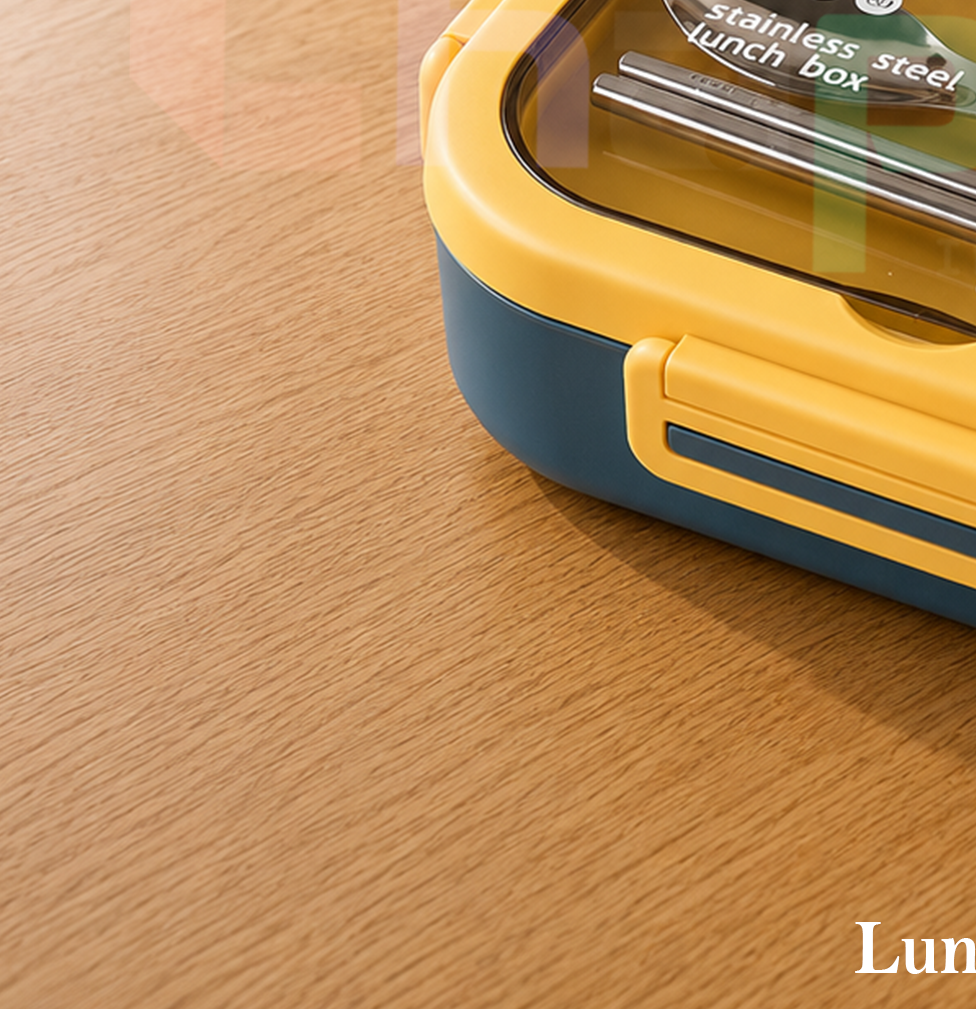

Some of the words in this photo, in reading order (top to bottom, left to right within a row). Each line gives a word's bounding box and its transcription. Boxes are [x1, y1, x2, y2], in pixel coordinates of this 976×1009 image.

[687, 21, 786, 69] lunch
[798, 53, 869, 93] box
[704, 3, 860, 60] stainless
[871, 52, 965, 92] steel
